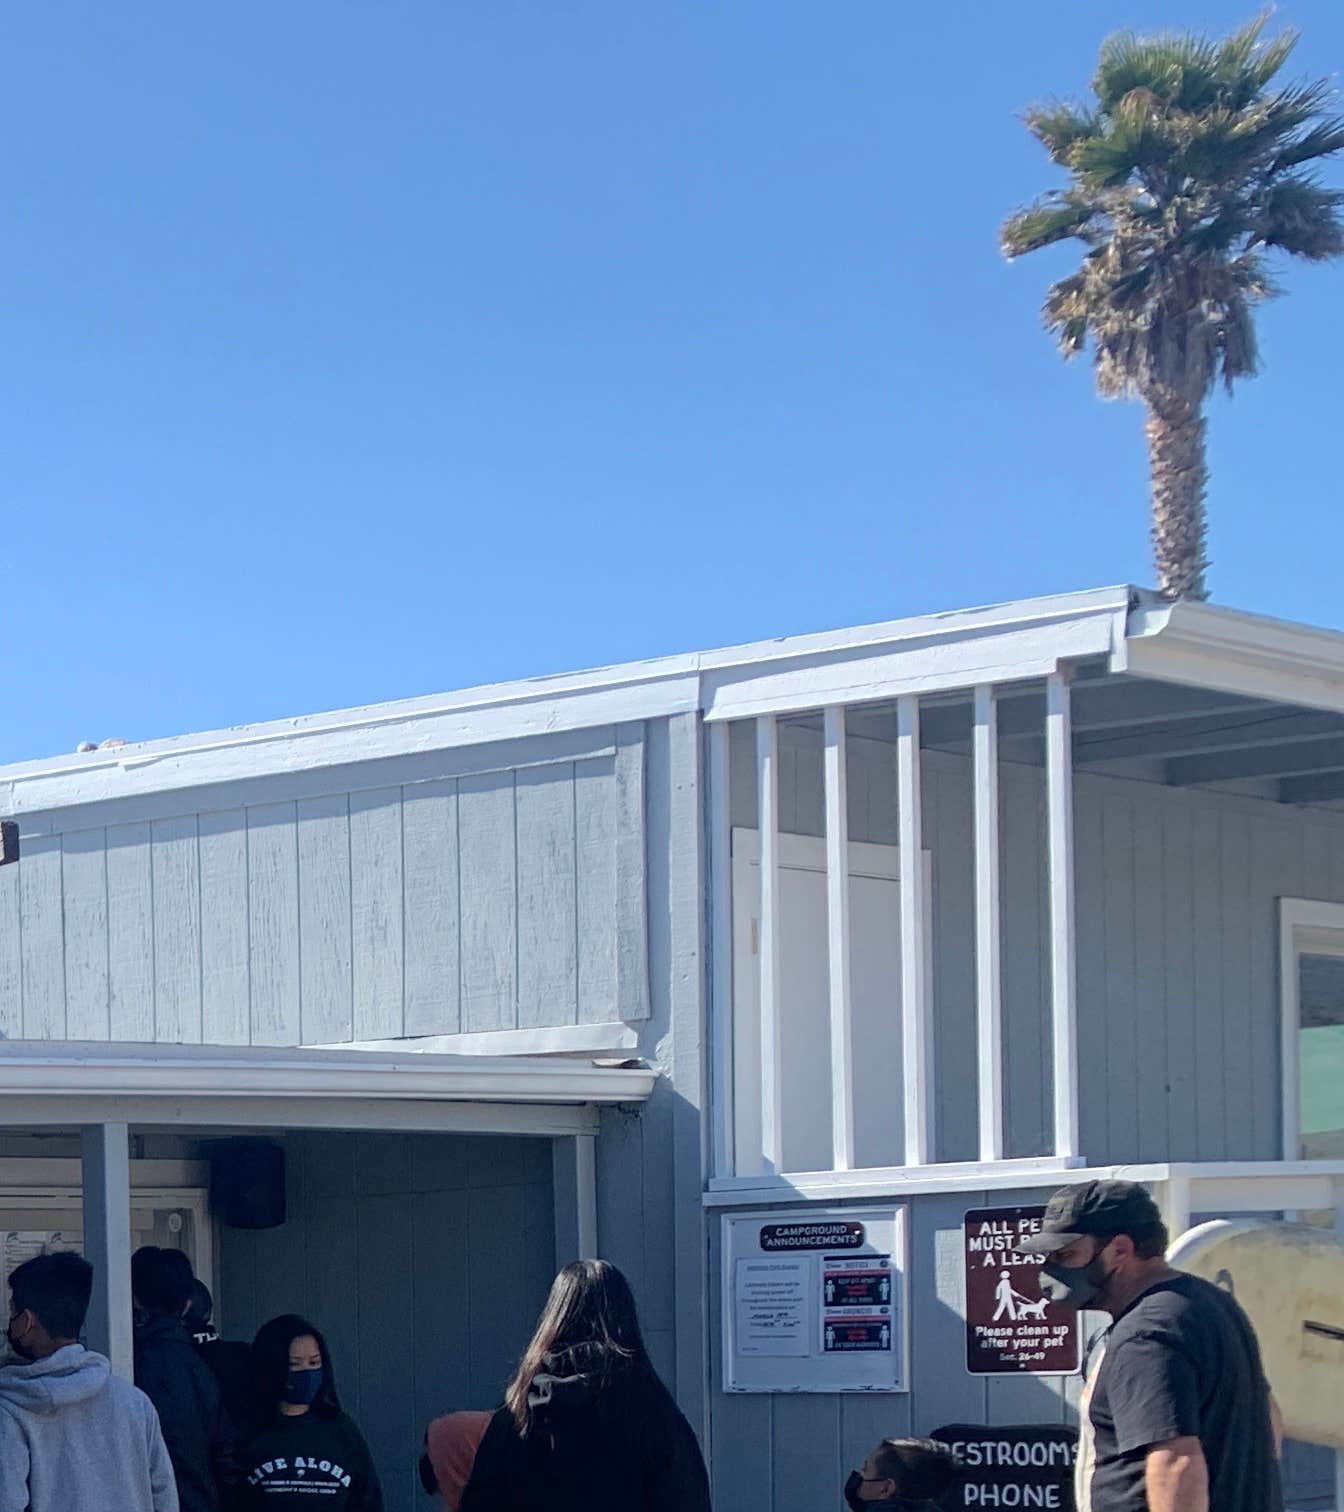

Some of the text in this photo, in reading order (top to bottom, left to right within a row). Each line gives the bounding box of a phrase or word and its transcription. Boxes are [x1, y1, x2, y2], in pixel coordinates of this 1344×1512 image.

[775, 1224, 847, 1236] CAMPGROUND
[979, 1217, 1041, 1236] ALL PE
[766, 1235, 858, 1246] ANNOUNCEMENTS
[969, 1235, 1015, 1251] MUST
[983, 1251, 1047, 1267] A LEAS
[975, 1325, 1070, 1337] Please clean up
[980, 1336, 1064, 1350] after your pet
[938, 1440, 1079, 1467] ESTROOM
[247, 1457, 288, 1486] LIVE
[294, 1456, 352, 1488] ALOHA
[963, 1483, 1061, 1508] PHONE
